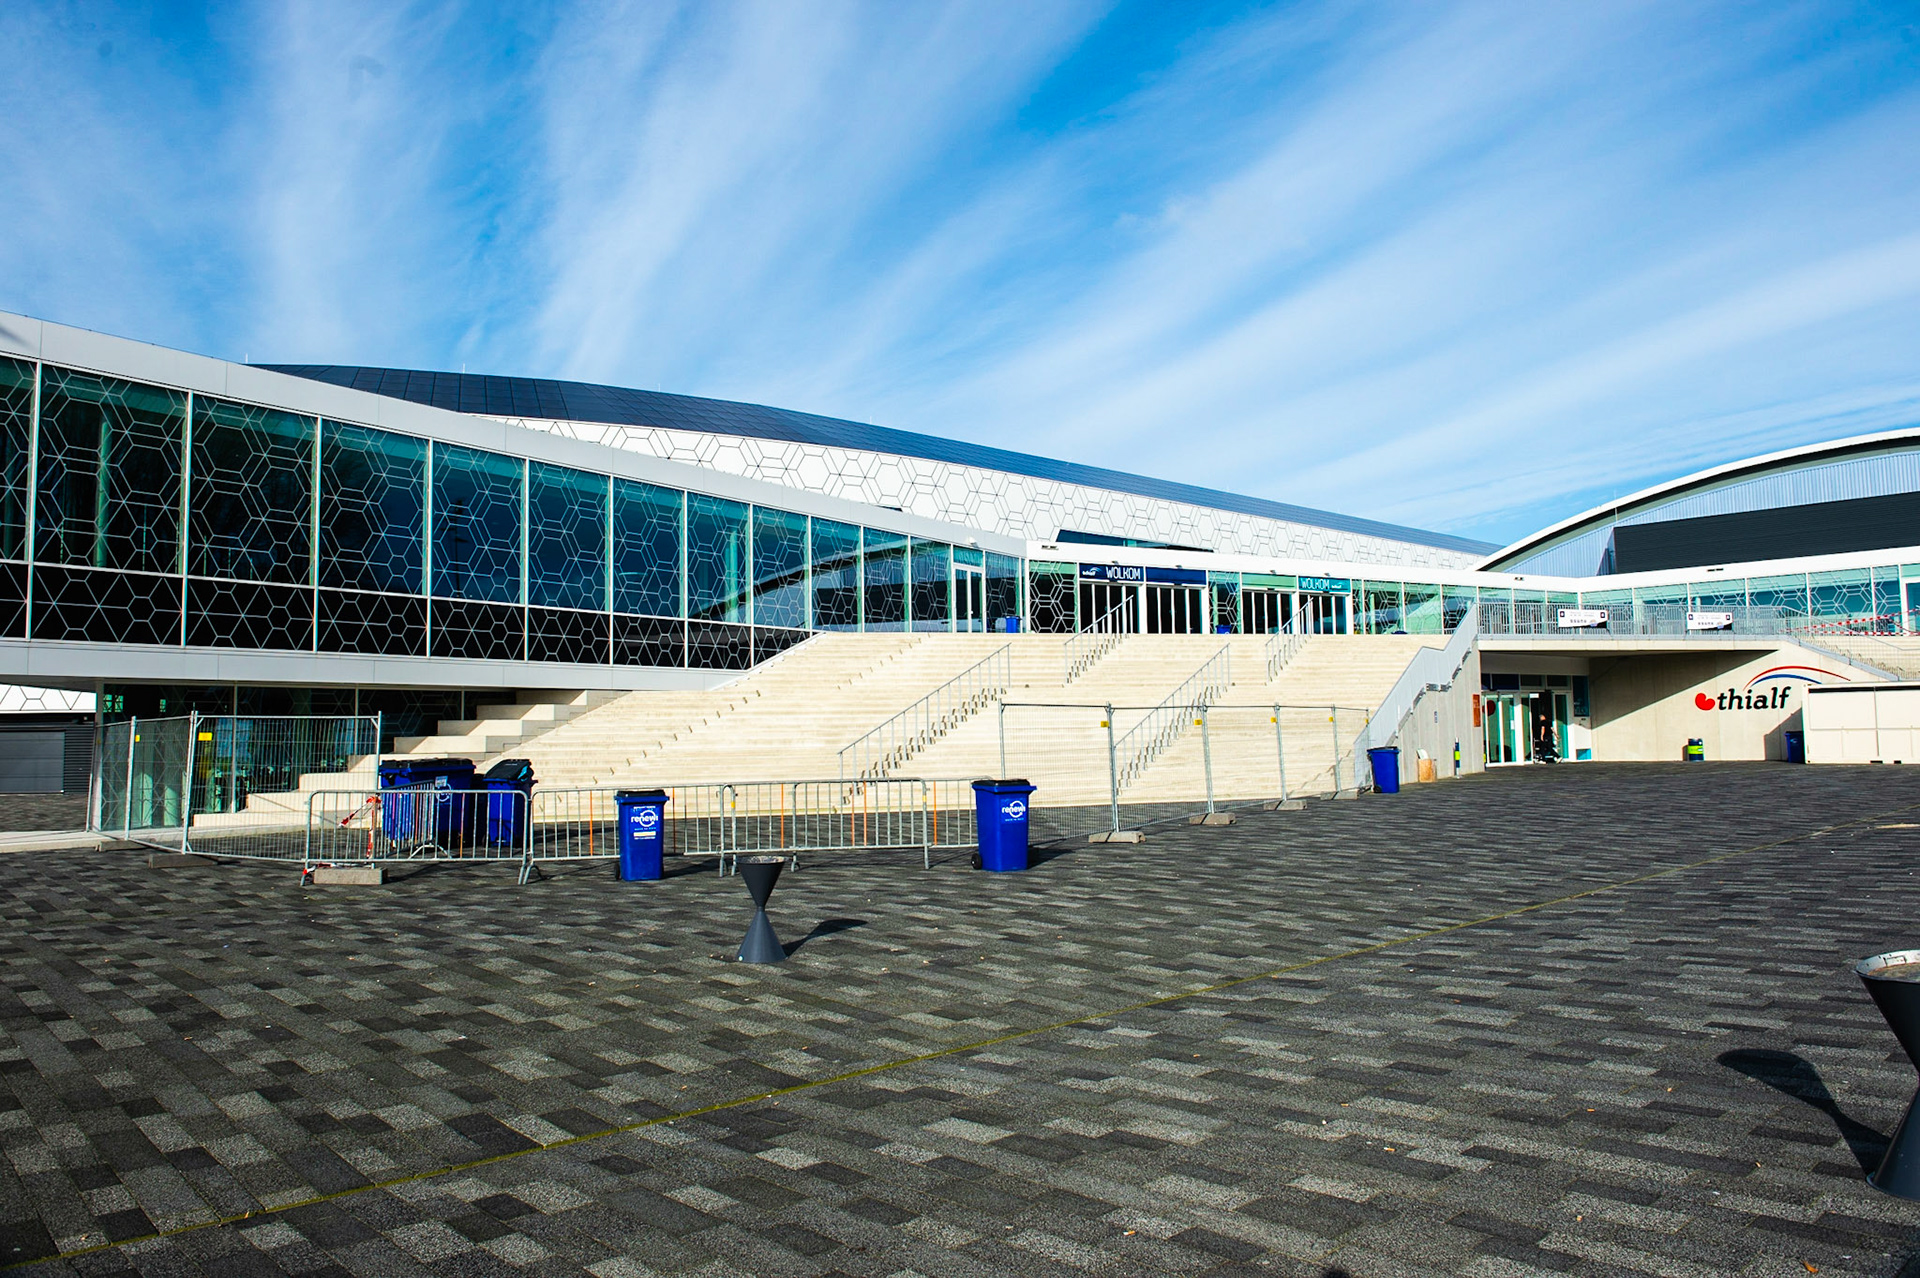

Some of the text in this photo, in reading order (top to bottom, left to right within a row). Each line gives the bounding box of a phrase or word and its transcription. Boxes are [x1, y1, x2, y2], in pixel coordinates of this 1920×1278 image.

[1106, 566, 1140, 580] WOLKOM
[1300, 578, 1330, 590] WOLKOM
[1717, 686, 1791, 710] thialf
